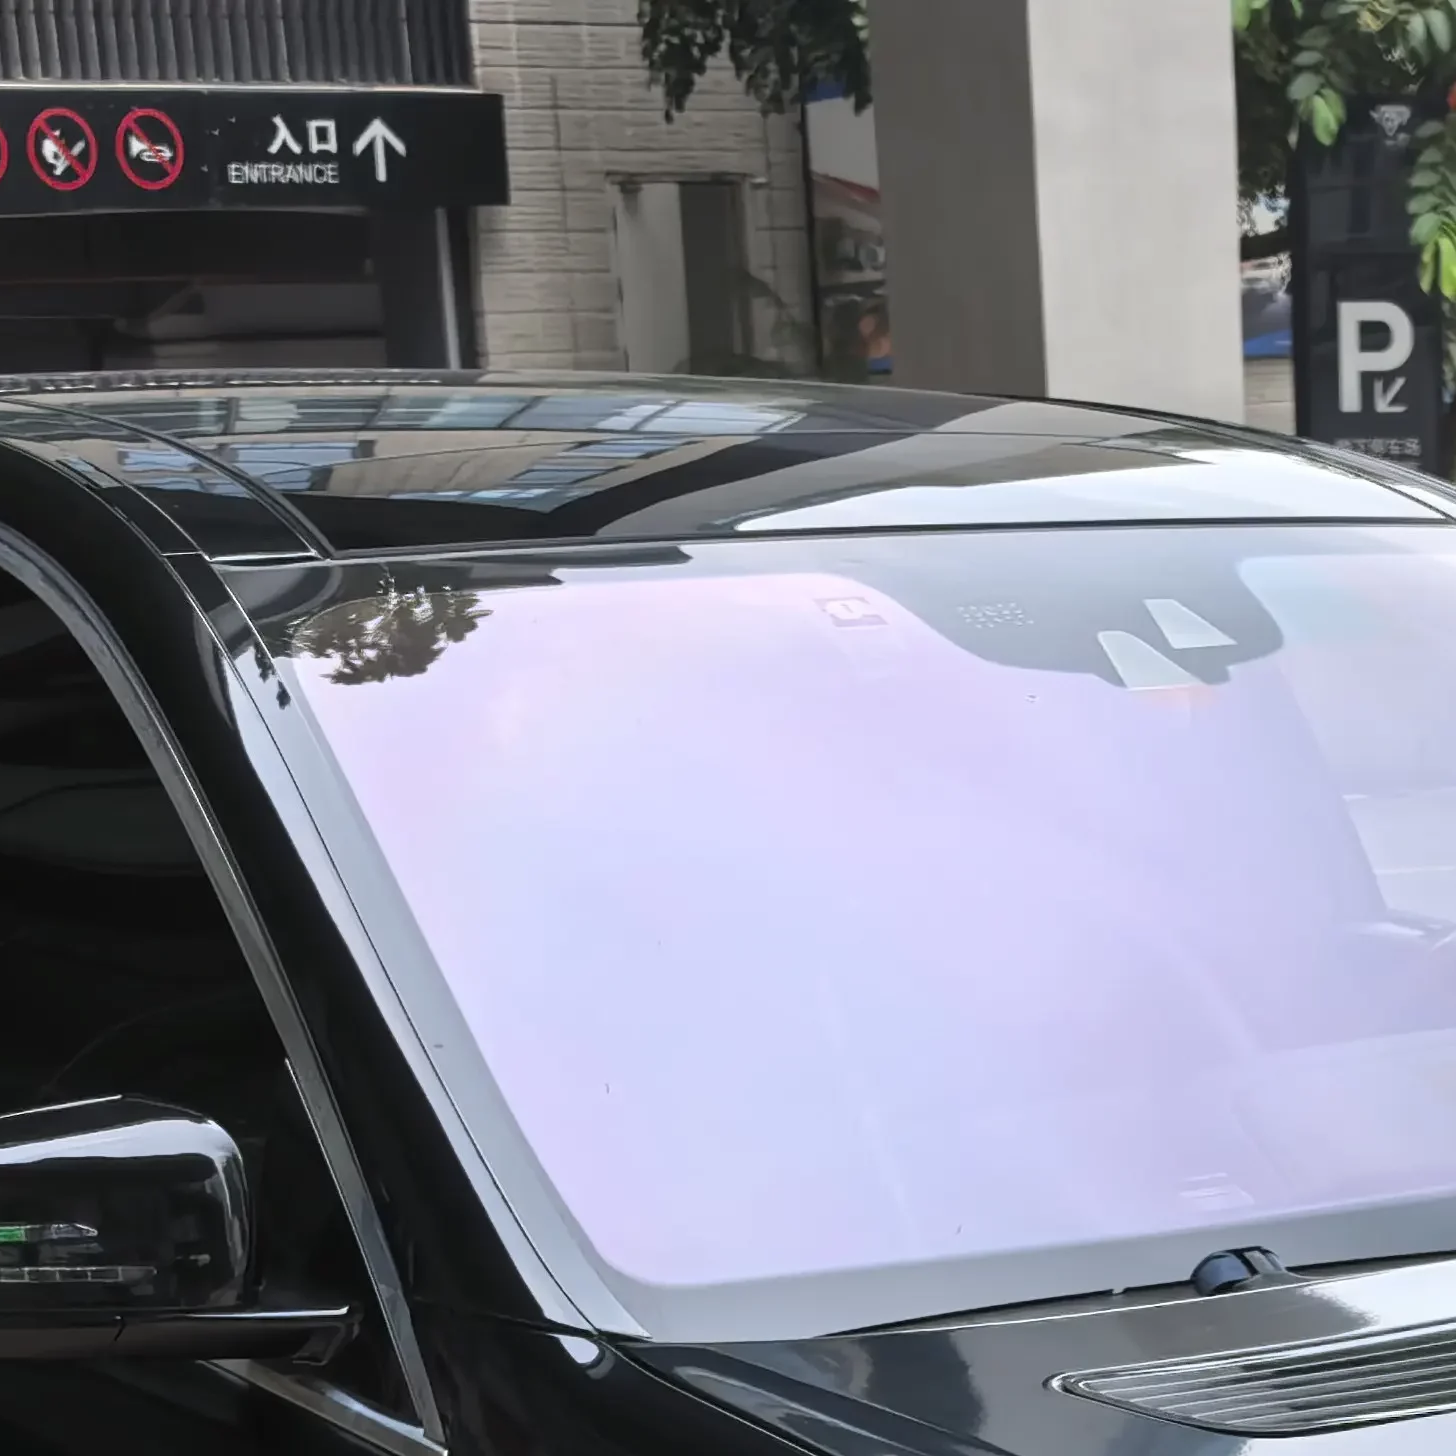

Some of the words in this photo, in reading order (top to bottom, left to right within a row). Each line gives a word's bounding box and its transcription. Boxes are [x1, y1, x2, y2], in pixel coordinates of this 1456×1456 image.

[267, 115, 338, 154] 入口
[227, 162, 339, 184] ENTRANCE
[1337, 301, 1415, 413] P
